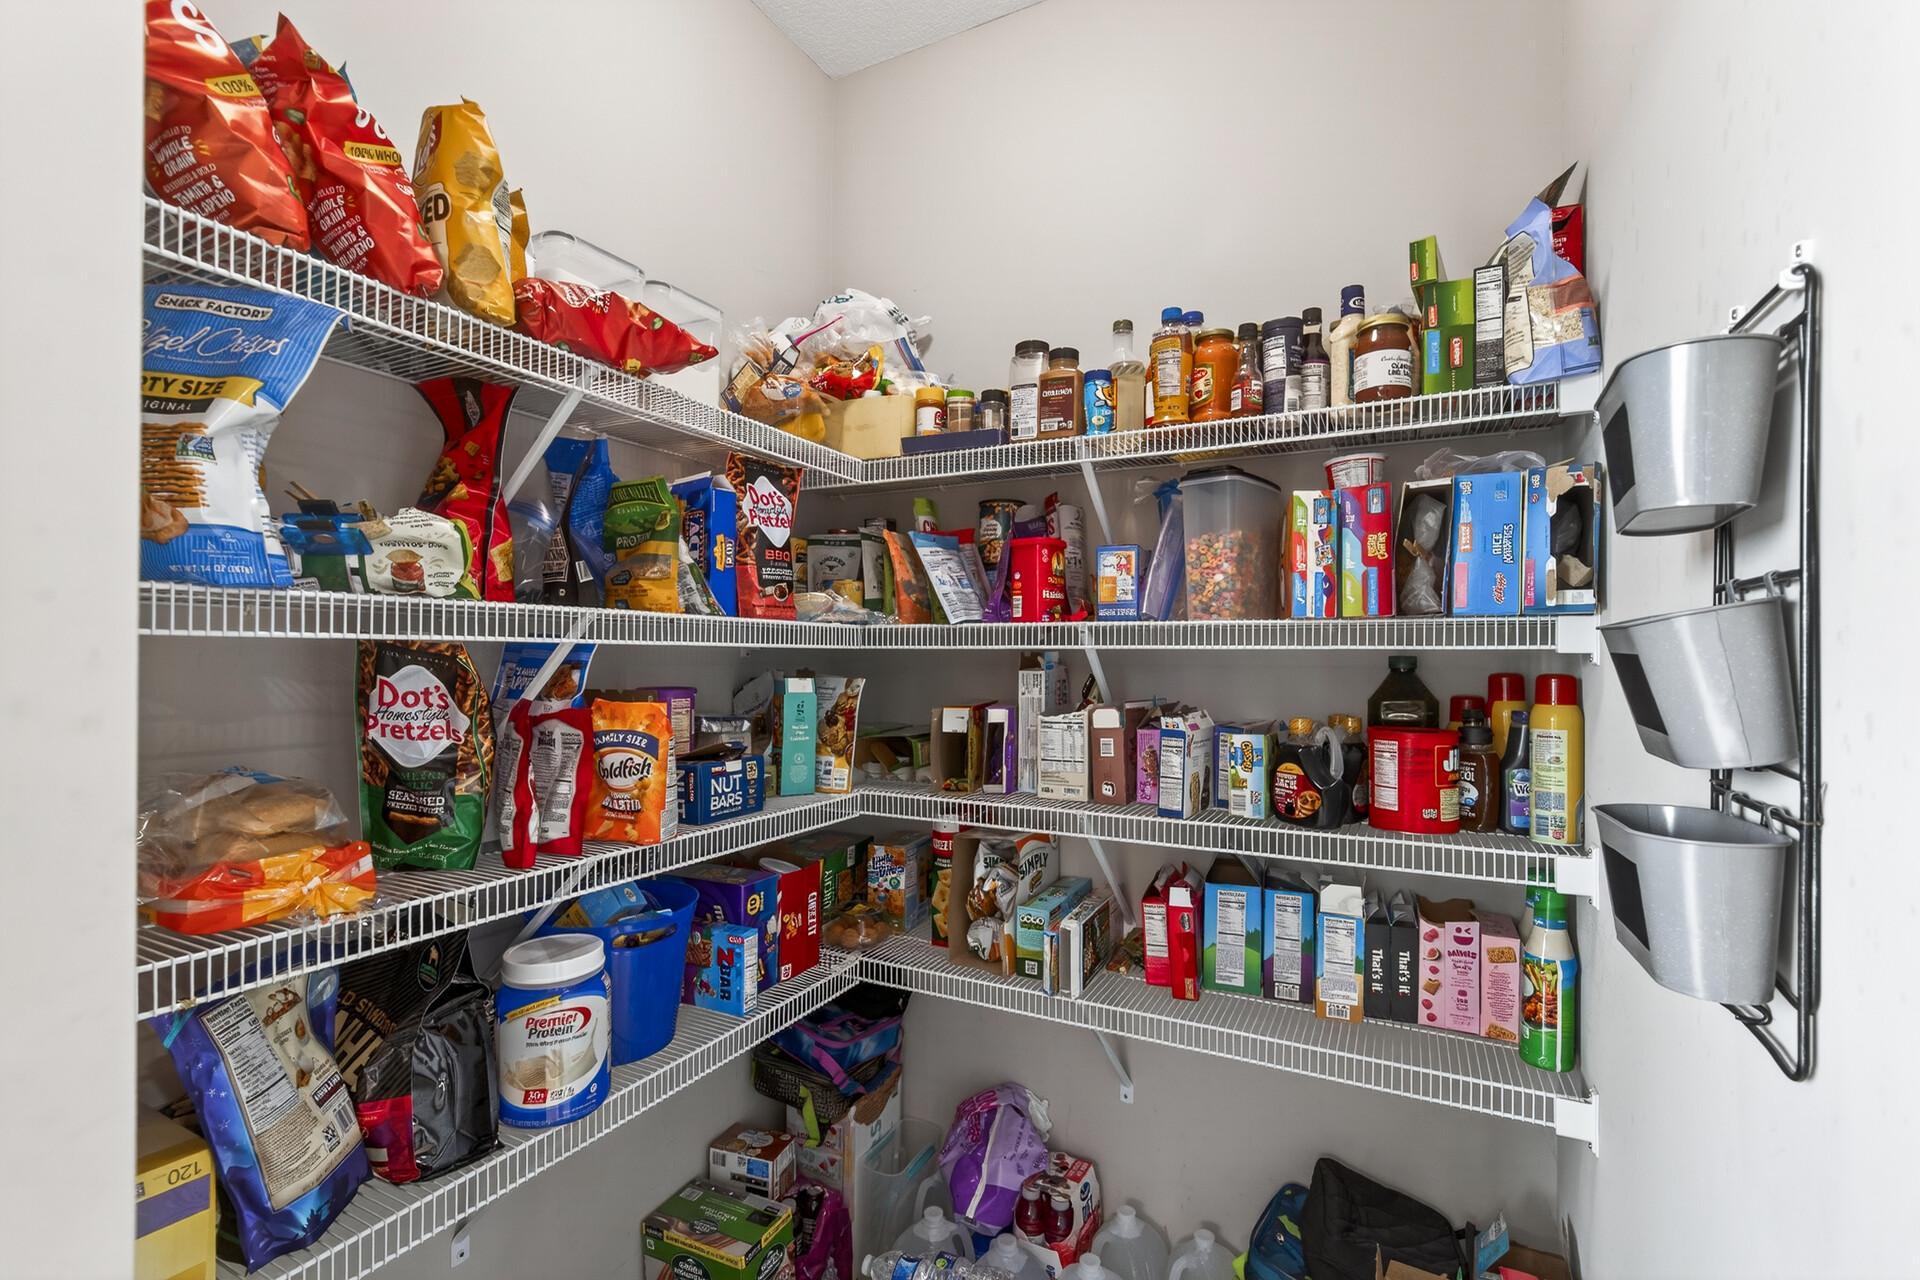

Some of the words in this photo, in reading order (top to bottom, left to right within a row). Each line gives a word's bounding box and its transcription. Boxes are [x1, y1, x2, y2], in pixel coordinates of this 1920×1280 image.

[214, 78, 254, 95] 100%
[375, 150, 402, 163] WHO
[158, 296, 203, 308] SNACK
[205, 301, 271, 318] FACTORY
[179, 380, 227, 396] SIZE
[144, 399, 192, 411] IGINAL
[748, 485, 785, 508] Dot's
[764, 549, 791, 562] BBQ
[378, 678, 449, 710] Dot's
[374, 706, 449, 727] Homestyle
[364, 713, 463, 743] Pretzels
[626, 734, 648, 748] SIZE
[598, 757, 652, 779] Goldfish
[711, 774, 742, 795] NUT
[711, 791, 743, 811] BARS
[1018, 852, 1049, 880] SIMPLY
[1371, 949, 1383, 980] That's
[1399, 951, 1410, 982] That's
[526, 1013, 578, 1030] Premier
[528, 1025, 573, 1039] Protein
[168, 1161, 202, 1185] 120
